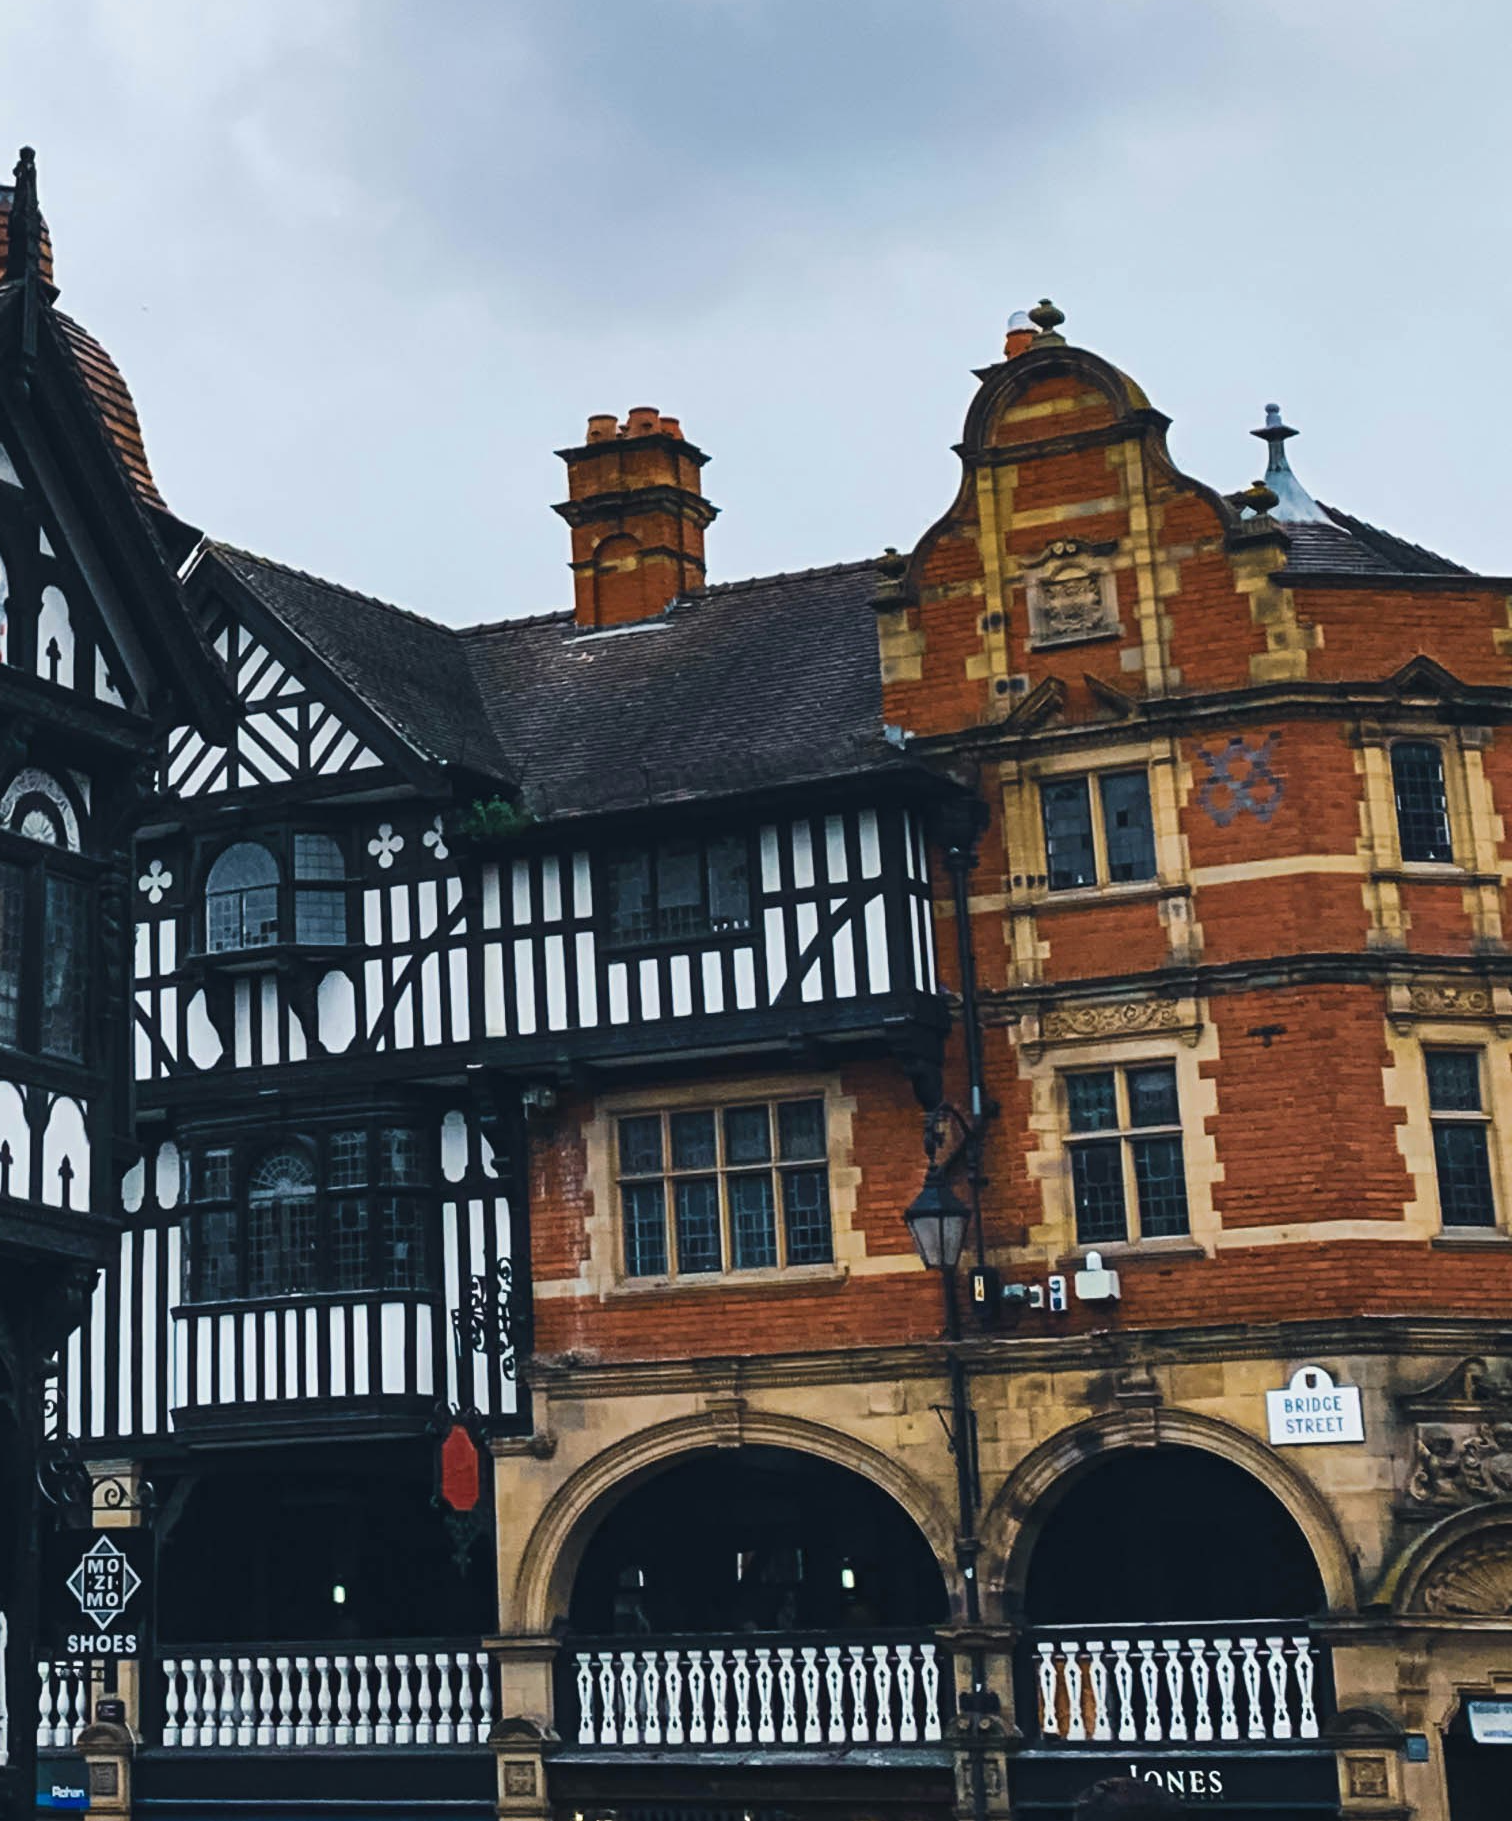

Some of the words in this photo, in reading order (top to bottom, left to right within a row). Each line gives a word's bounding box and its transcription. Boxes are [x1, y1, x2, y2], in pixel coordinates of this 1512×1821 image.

[1284, 1395, 1342, 1413] BRIDGE
[1286, 1417, 1345, 1434] STREET
[88, 1559, 120, 1574] MO
[86, 1592, 119, 1607] MO
[67, 1634, 137, 1653] SHOES
